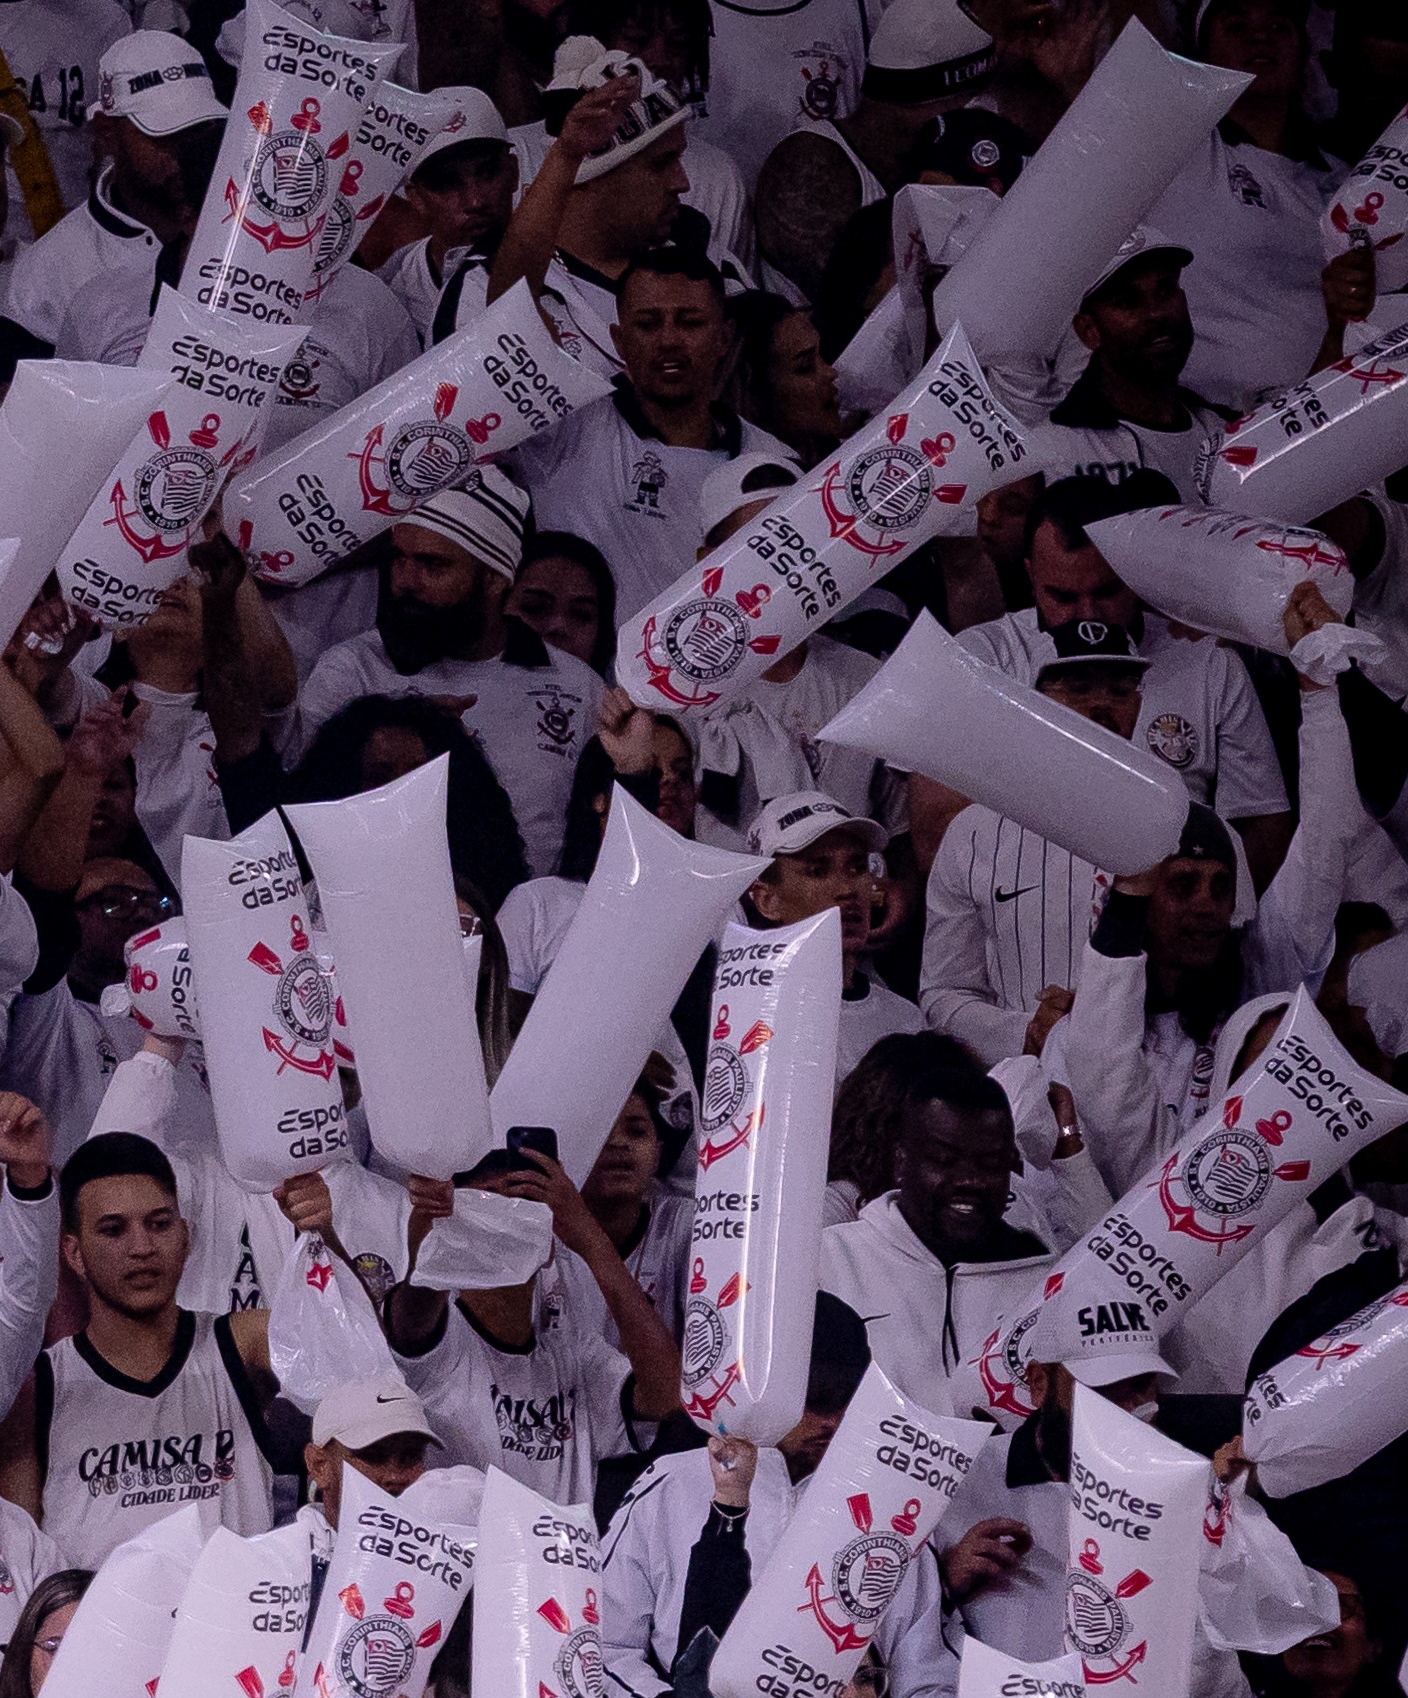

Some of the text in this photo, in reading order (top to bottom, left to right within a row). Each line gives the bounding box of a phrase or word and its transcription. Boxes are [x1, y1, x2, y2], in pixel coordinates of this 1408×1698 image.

[263, 26, 377, 81] Esportes
[58, 67, 85, 127] 12
[760, 516, 839, 608] Esportes
[1276, 1035, 1373, 1130] Esportes
[1104, 1213, 1192, 1301] Esportes
[1078, 1301, 1150, 1336] SALVE
[78, 1433, 202, 1484] CAMISA
[121, 1488, 176, 1508] CIDADE
[359, 1506, 475, 1568] Esportes
